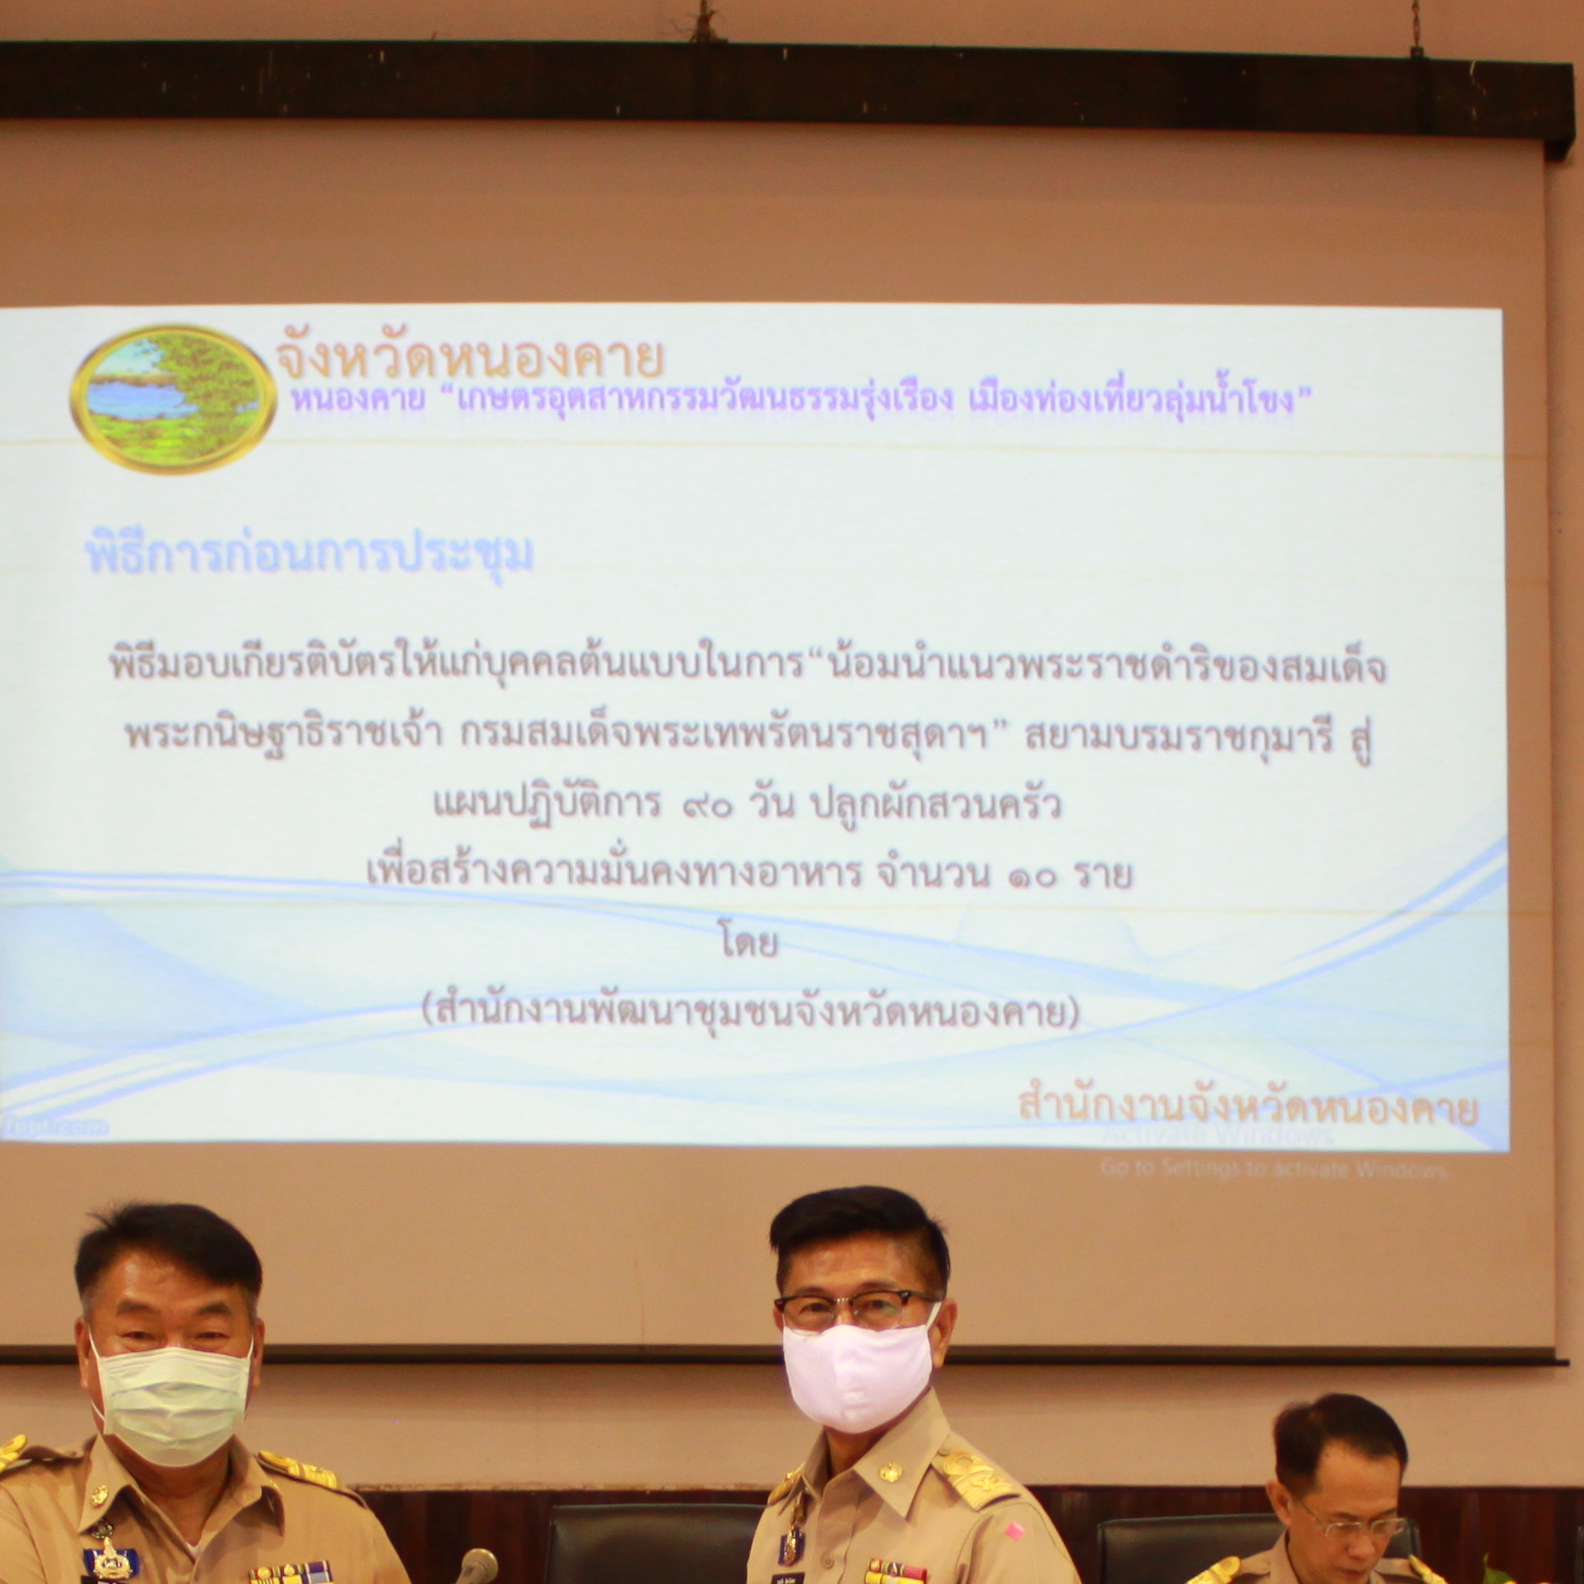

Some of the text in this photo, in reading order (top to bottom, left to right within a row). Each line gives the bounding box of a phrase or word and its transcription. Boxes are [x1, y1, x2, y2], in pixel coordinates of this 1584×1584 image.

[274, 324, 666, 380] จังหวัดหนองคาย
[292, 386, 426, 412] หนองคาย
[84, 525, 535, 587] พิธีการก่อนการประชุม
[123, 704, 1374, 768] พระกนิษฐาธิราชเจ้า กรมสมเด็จพระเทพรัตนราชสุดาฯ” สยามบรมราชกุมารี สู่
[433, 778, 1064, 833] แผนปฏิบัติการ ๙๐ วัน ปลูกผักสวนครัว
[366, 837, 1135, 890] เพื่อสร้างความมั่นคงทางอาหาร จำนวน ๑๐ ราย
[716, 917, 779, 958] โดย
[421, 983, 1080, 1040] (สำนักงานพัฒนาชุมชนจังหวัดหนองคาย)
[1017, 1078, 1479, 1128] สำนักงานจังหวัดหนองคาย
[1101, 1158, 1130, 1177] Go
[1135, 1159, 1154, 1177] to
[1161, 1158, 1240, 1181] Settings
[1245, 1160, 1267, 1178] to
[1271, 1160, 1350, 1180] activate
